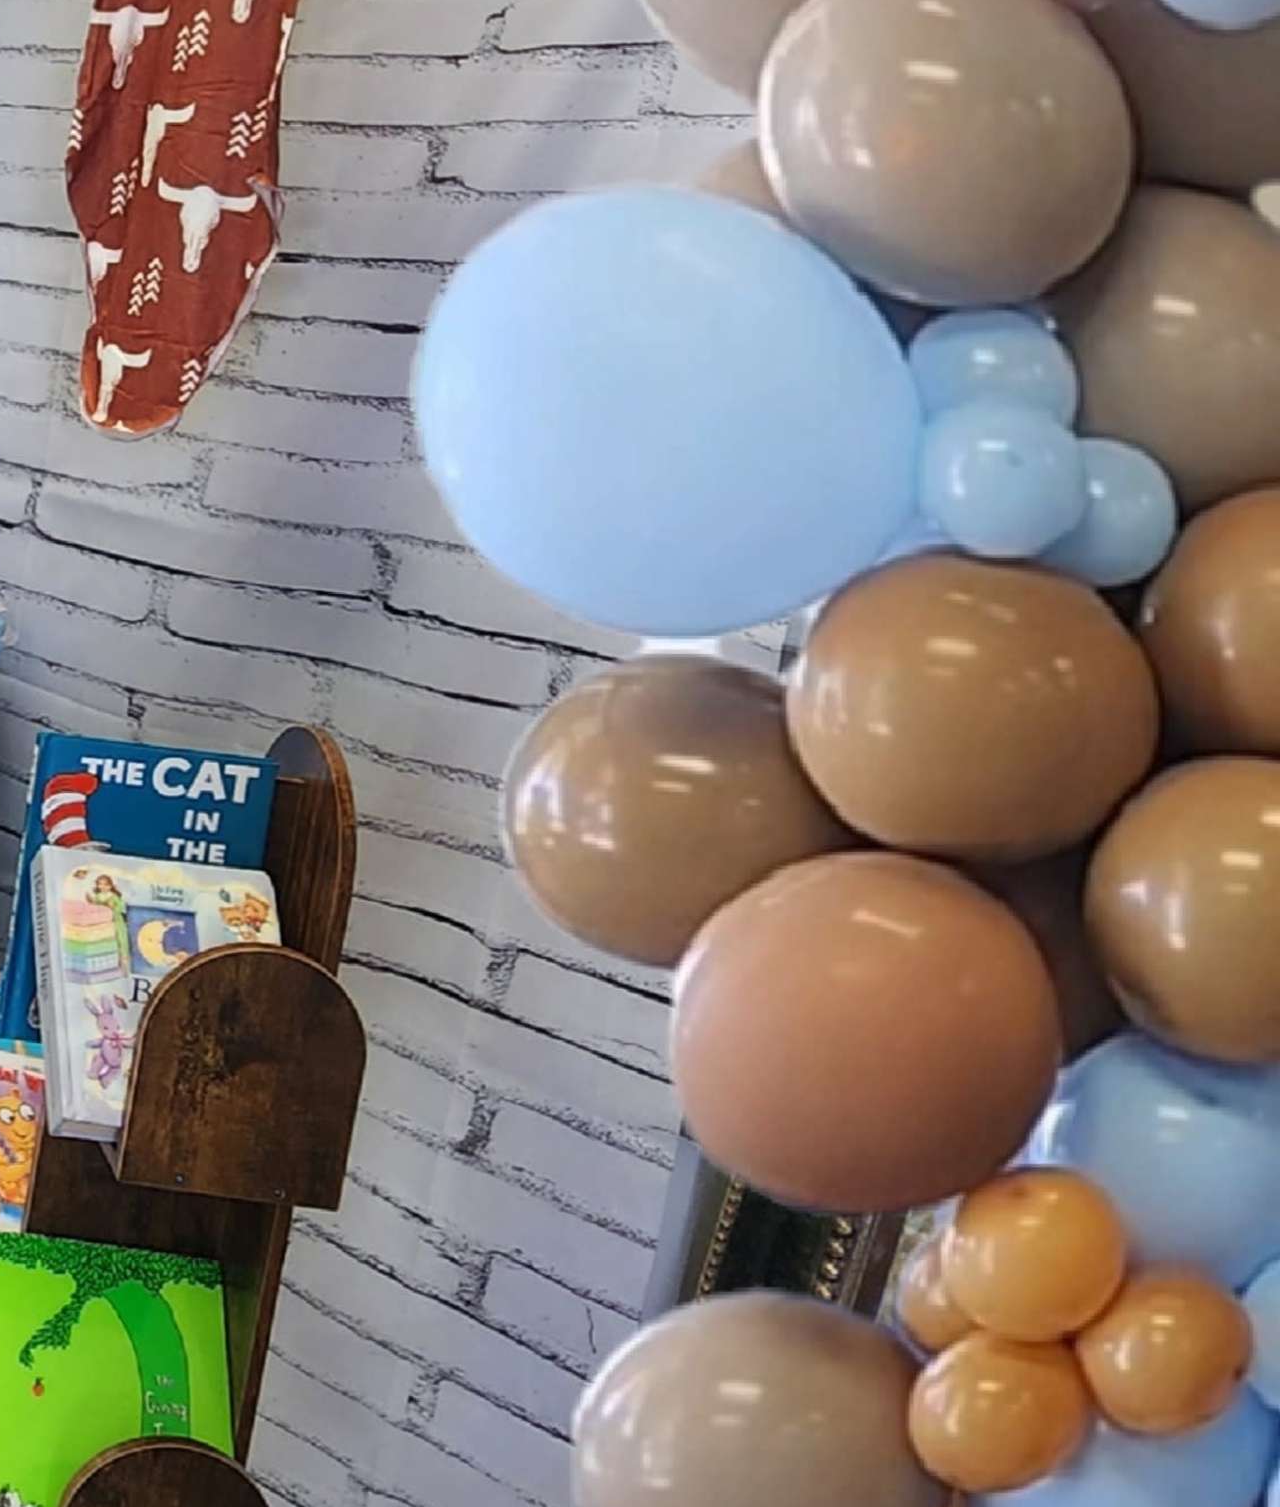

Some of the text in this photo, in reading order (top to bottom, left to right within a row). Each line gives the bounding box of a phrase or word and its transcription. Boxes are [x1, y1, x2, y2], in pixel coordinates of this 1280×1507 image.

[80, 756, 261, 804] THE CAT
[183, 809, 220, 833] IN
[166, 837, 227, 865] THE
